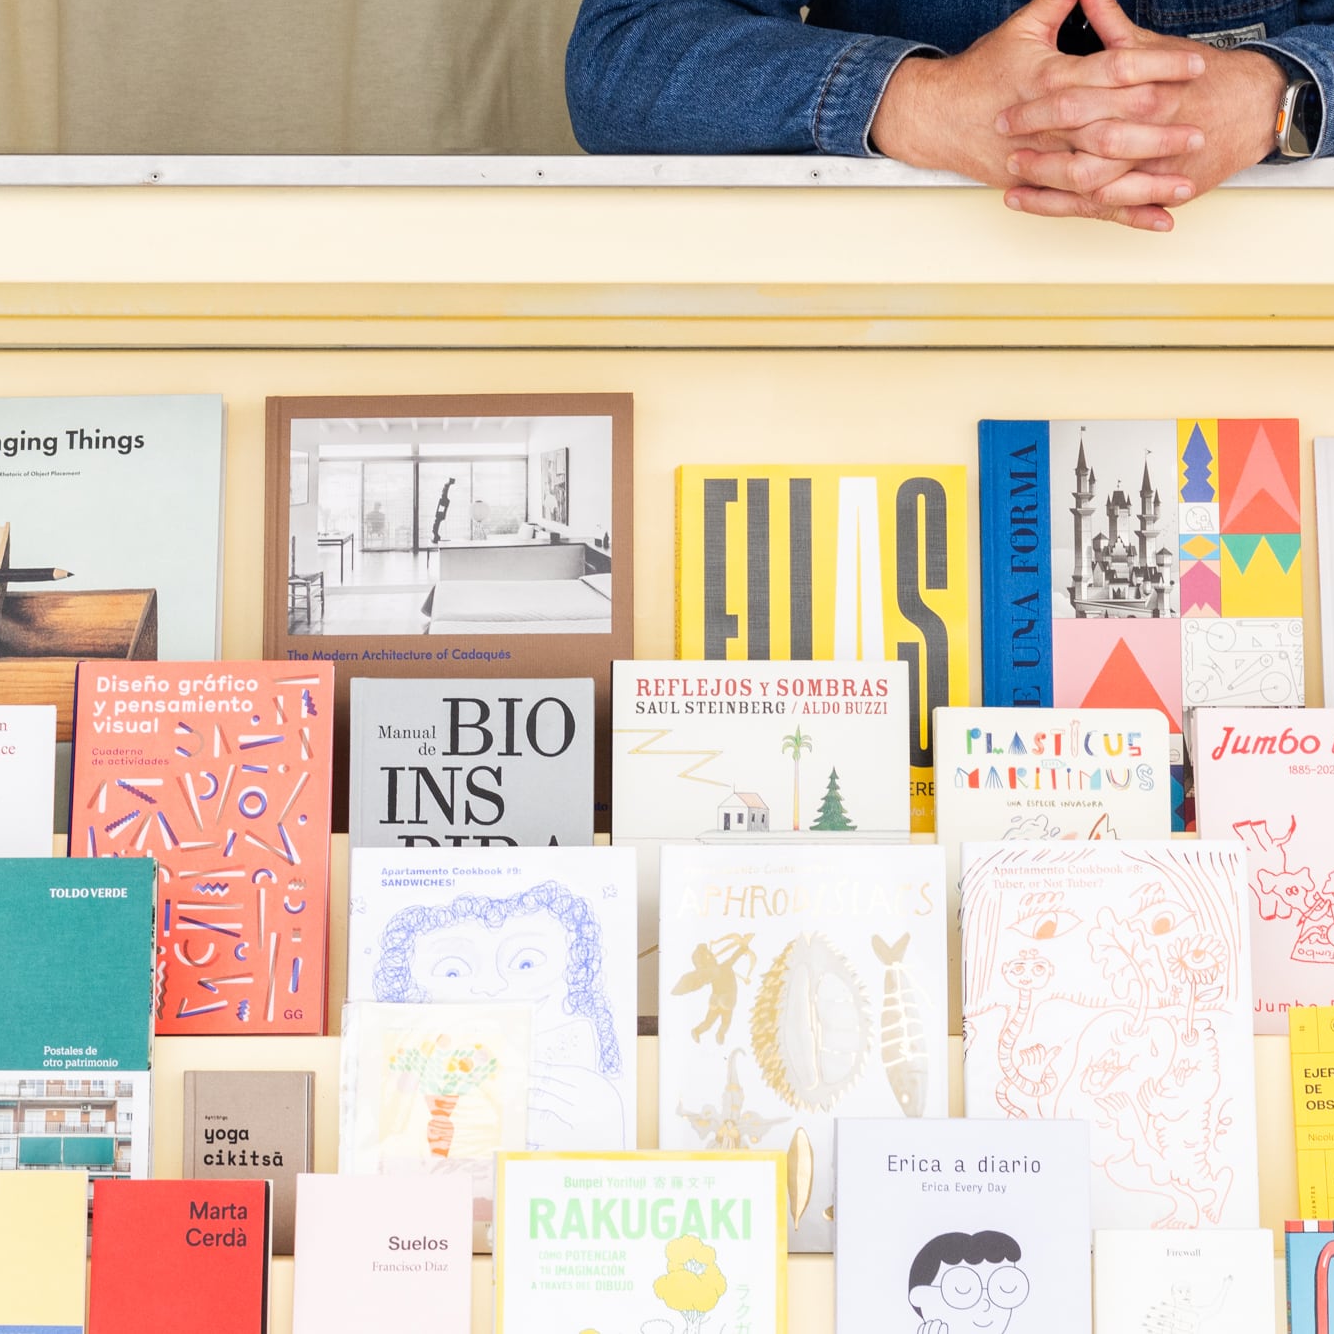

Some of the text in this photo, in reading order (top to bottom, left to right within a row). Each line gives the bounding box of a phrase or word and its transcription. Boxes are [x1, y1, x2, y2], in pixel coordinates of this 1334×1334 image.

[66, 429, 144, 454] Things
[288, 649, 511, 662] The Modern Architecture of Cadaqués
[97, 674, 258, 696] Diseño gráfico
[637, 679, 887, 696] REFLEJOS Y SOMBRAS
[93, 695, 253, 716] y pensamiento
[636, 702, 887, 714] SAUL STEINBERG ALDO BUZZI
[93, 716, 158, 733] visual
[379, 725, 435, 738] Manual
[442, 697, 575, 757] BIO
[419, 742, 435, 755] de
[1212, 727, 1320, 760] Jumbo
[380, 766, 504, 825] INS
[50, 888, 127, 898] TOLDO VERDE
[44, 1046, 97, 1055] Postales de
[43, 1057, 118, 1069] otro patrimonio
[1305, 1084, 1322, 1094] DE
[205, 1129, 249, 1144] yoga
[190, 1201, 247, 1219] Marta
[529, 1198, 751, 1240] RAKUGAKI
[186, 1228, 246, 1247] Cerdà
[389, 1236, 448, 1250] Suelos
